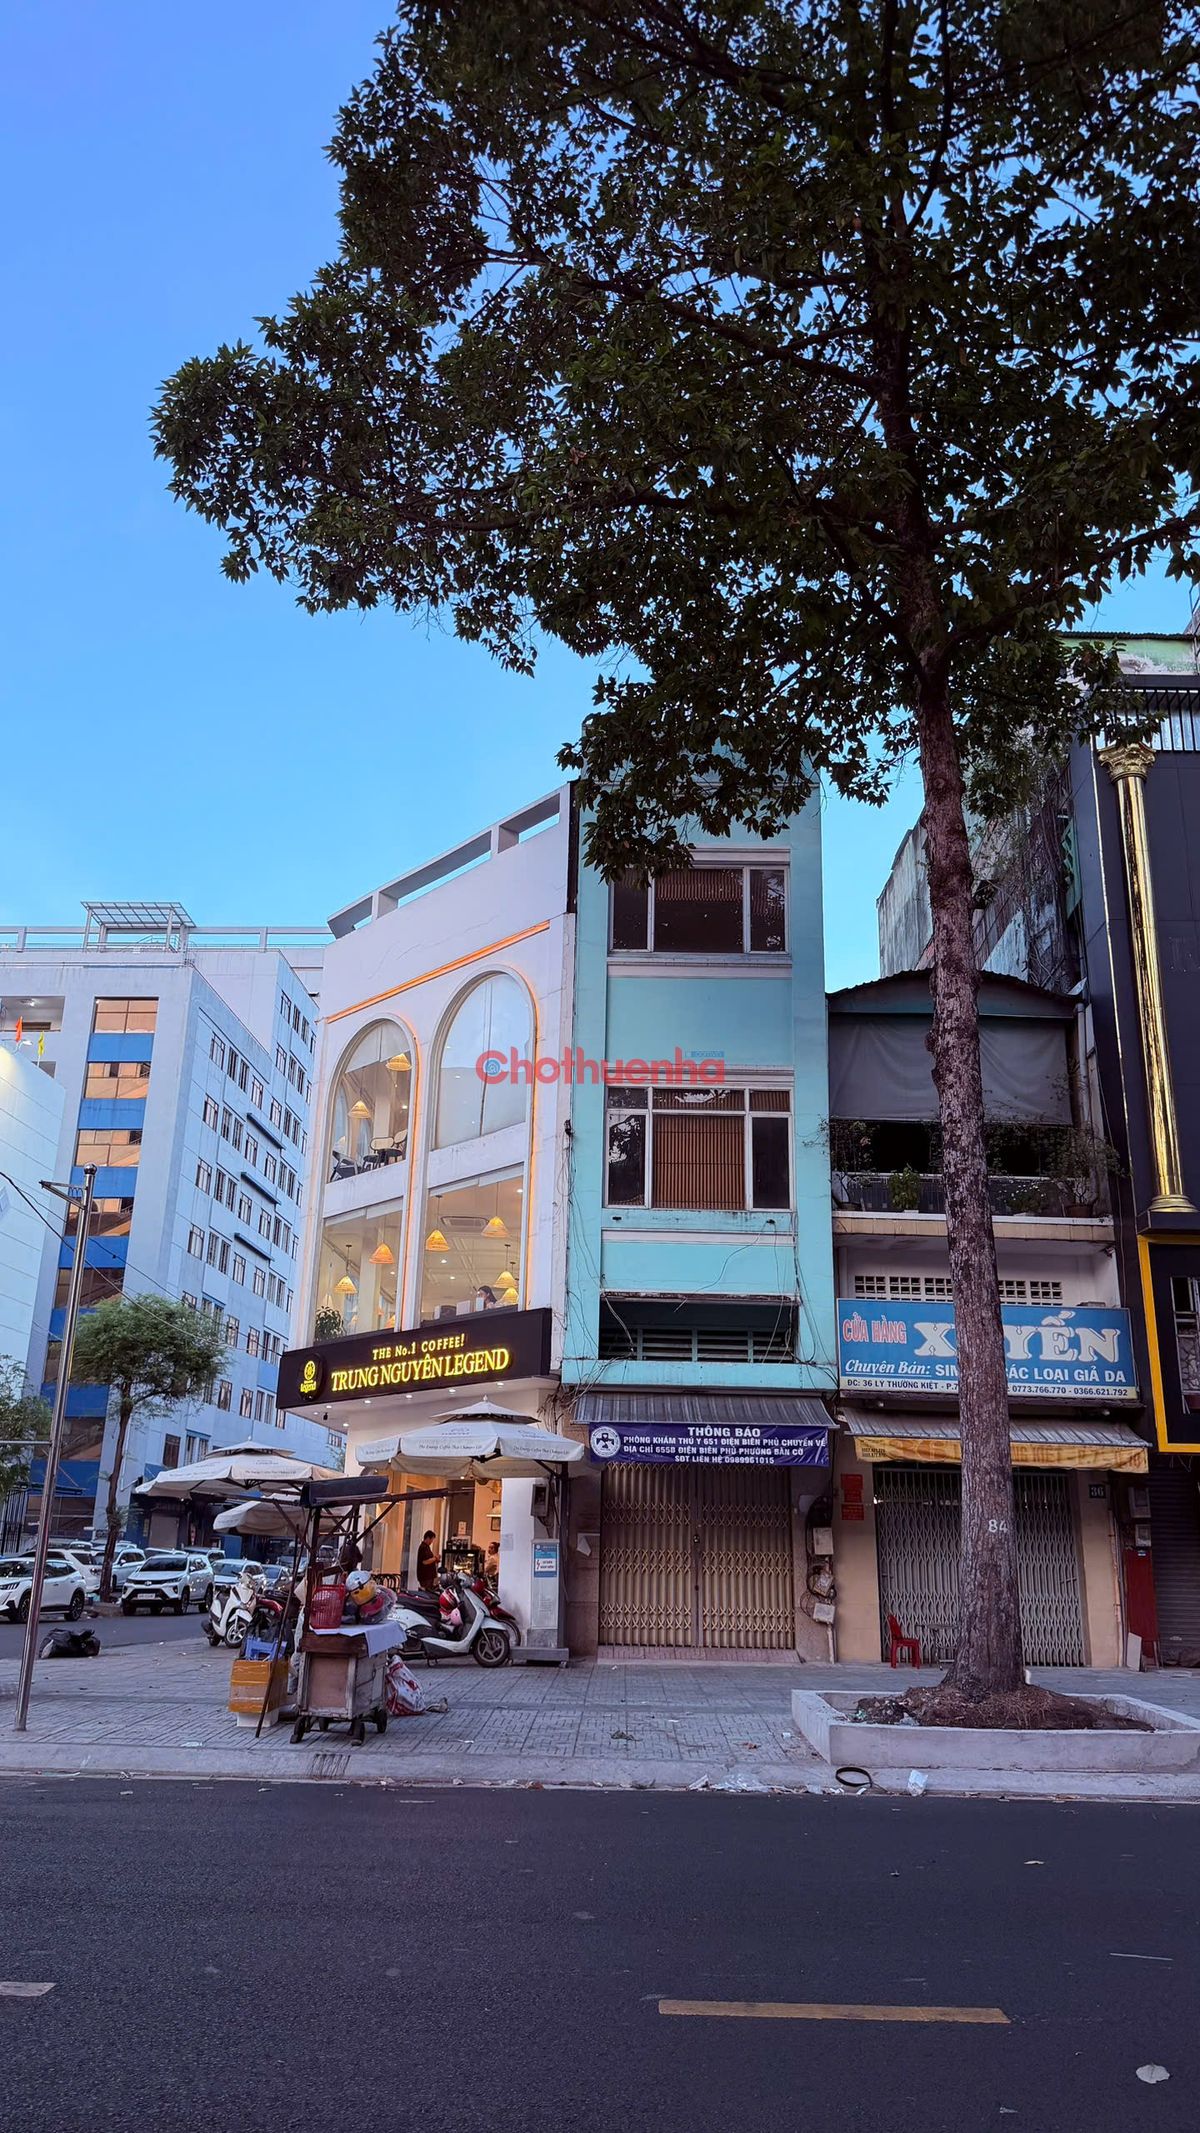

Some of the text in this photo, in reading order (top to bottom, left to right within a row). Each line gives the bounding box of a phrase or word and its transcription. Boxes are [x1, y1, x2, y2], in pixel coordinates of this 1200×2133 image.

[842, 1310, 1120, 1363] CỬA HÀNG XYẾN
[372, 1333, 465, 1360] THE No.1 COFFEE!
[331, 1348, 509, 1392] TRUNG NGUYÊN LEGEND
[846, 1360, 894, 1374] Chuyên
[898, 1361, 930, 1374] Bán:
[1005, 1364, 1029, 1380] ÁC
[1034, 1368, 1068, 1383] LOẠI
[1074, 1366, 1100, 1382] GIẢ
[875, 1379, 884, 1387] LÝ
[921, 1380, 938, 1390] KIỆT
[1012, 1385, 1066, 1394] 0773.766.770
[1074, 1387, 1128, 1396] 0366.621.792
[688, 1425, 761, 1438] THÔNG BÁO
[624, 1435, 650, 1444] PHÒNG
[653, 1436, 676, 1444] KHÁM
[678, 1436, 694, 1445] THÚ
[704, 1438, 718, 1446] 651
[742, 1438, 761, 1446] BIÊN
[763, 1437, 780, 1446] PHỦ
[624, 1446, 637, 1454] ĐỊA
[700, 1446, 718, 1454] BIÊN
[720, 1446, 737, 1455] PHỦ
[774, 1447, 790, 1456] BÀN
[692, 1455, 710, 1463] LIÊN
[1090, 1487, 1104, 1496] 36
[988, 1518, 1008, 1534] 84
